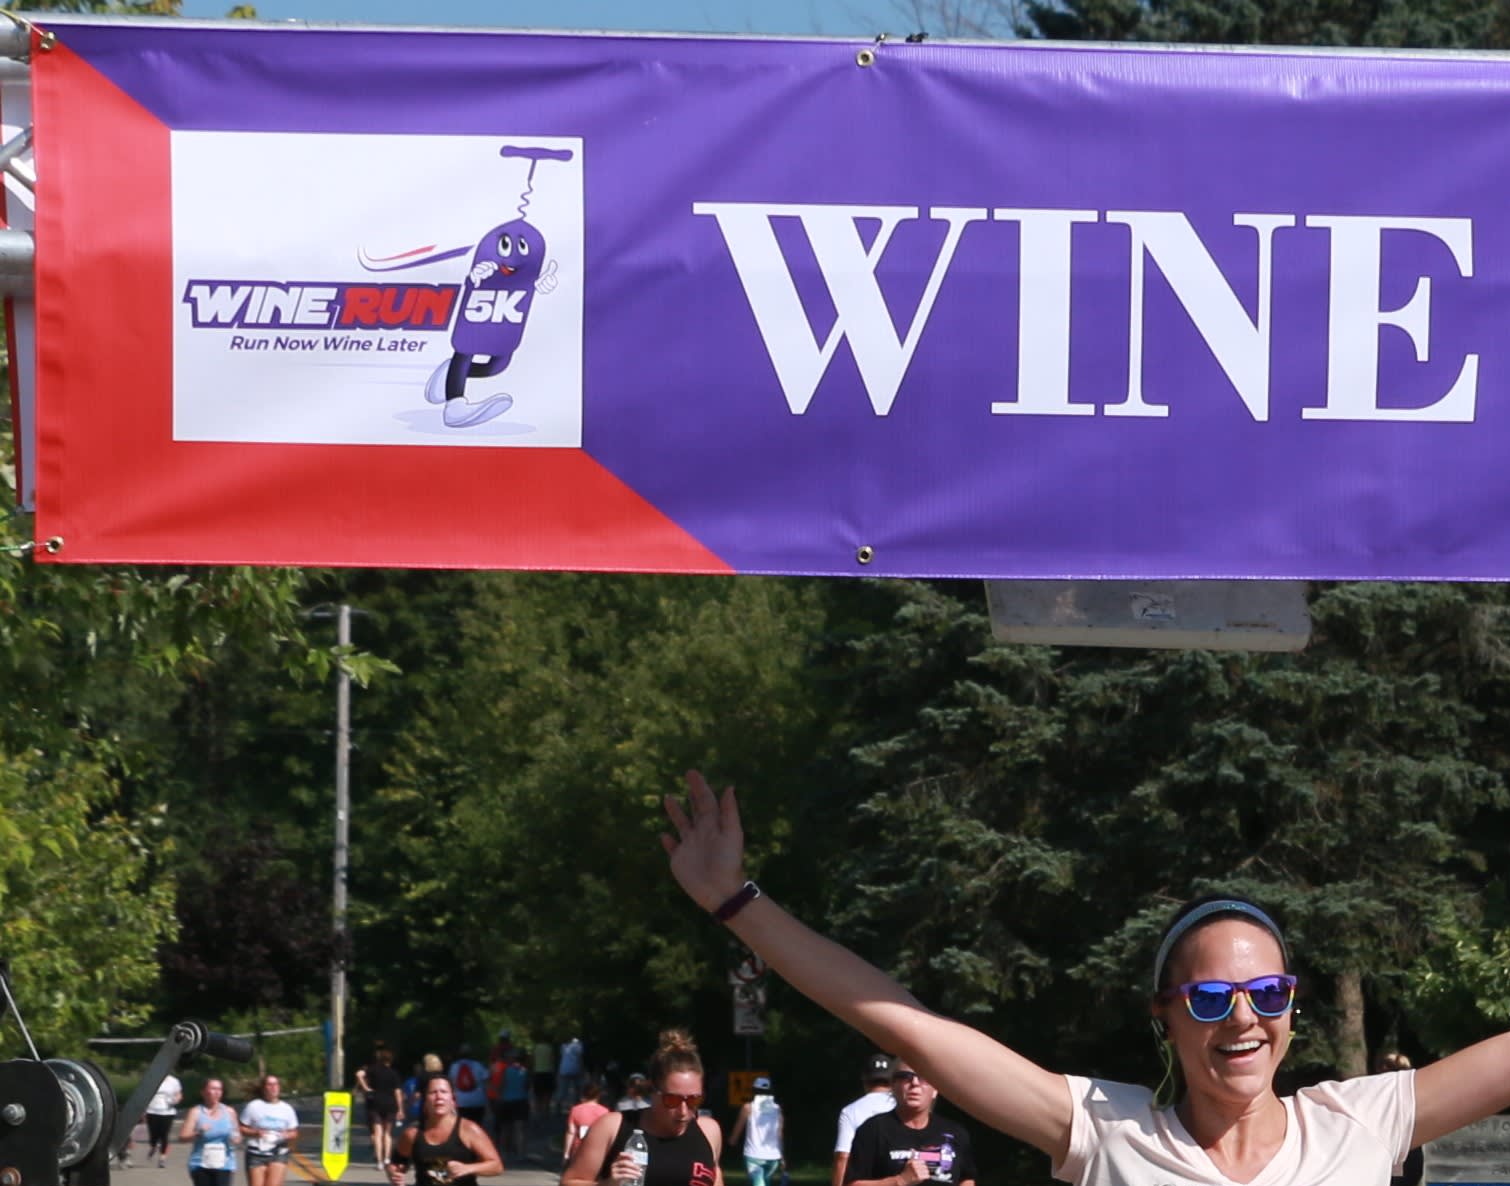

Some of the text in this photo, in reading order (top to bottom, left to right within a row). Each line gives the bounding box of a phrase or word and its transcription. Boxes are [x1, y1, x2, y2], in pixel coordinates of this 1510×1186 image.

[189, 285, 525, 326] WINE RUN 5K
[693, 202, 1479, 422] WINE
[230, 335, 427, 353] Run Now Wine Later
